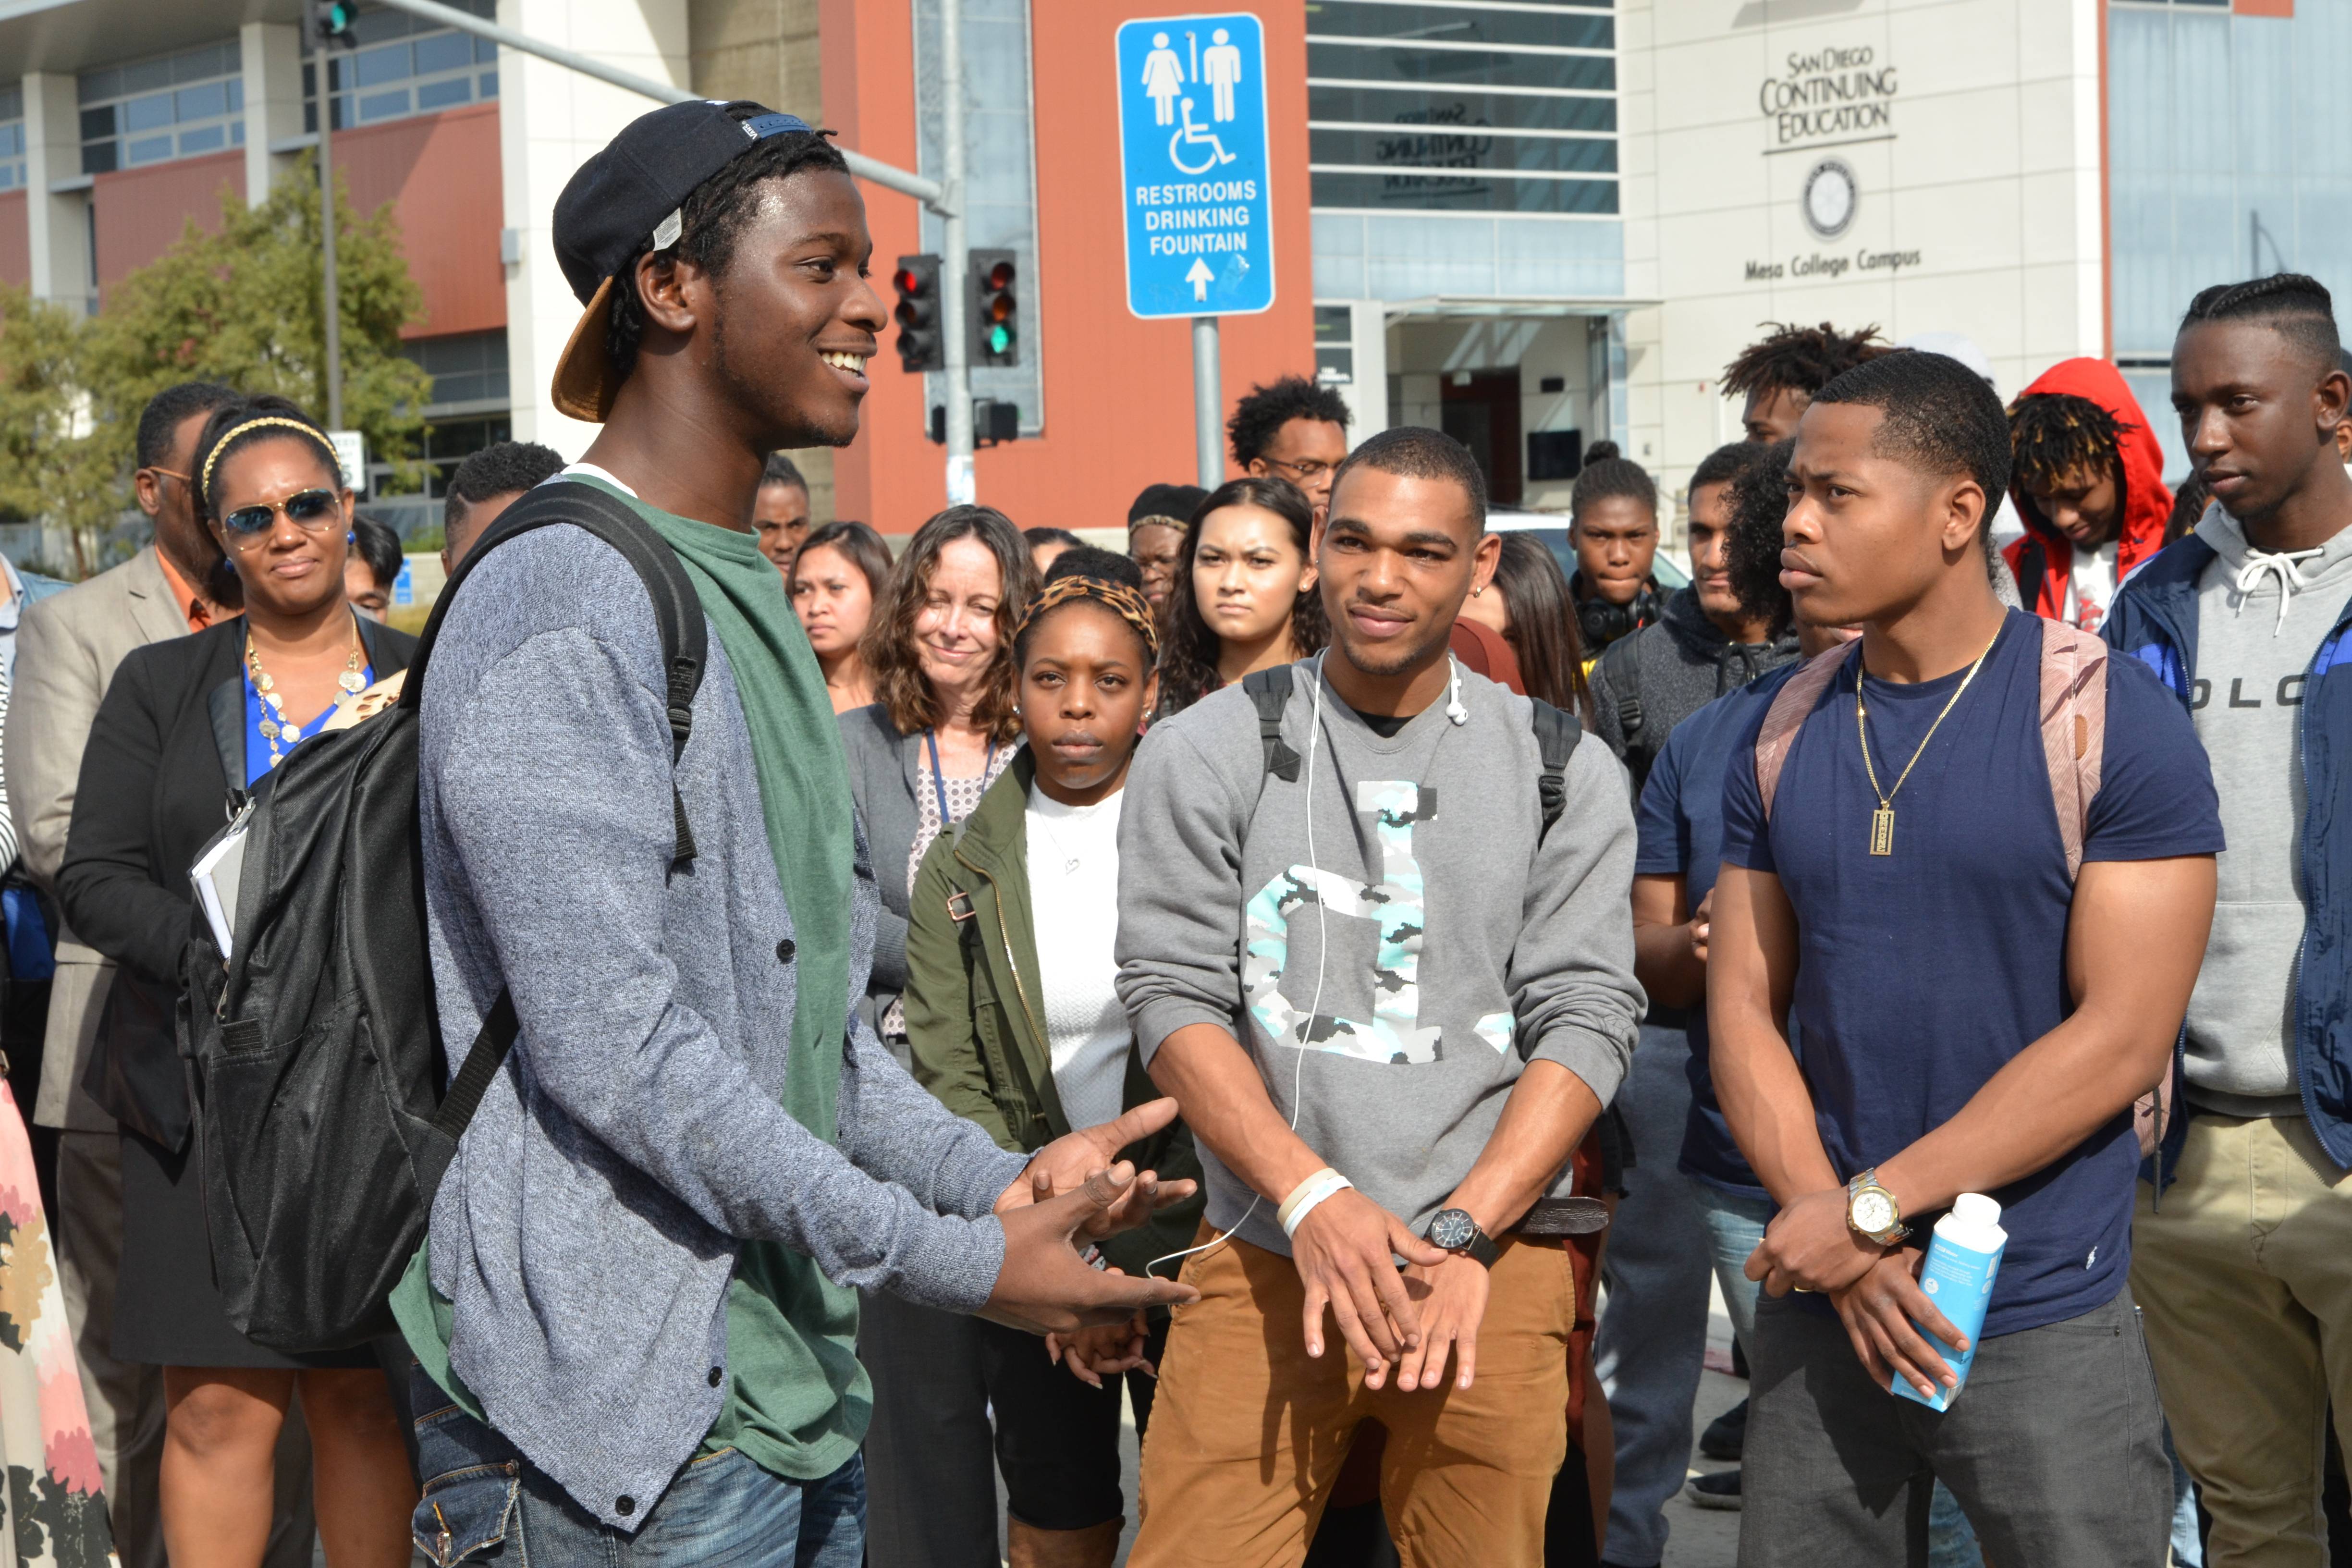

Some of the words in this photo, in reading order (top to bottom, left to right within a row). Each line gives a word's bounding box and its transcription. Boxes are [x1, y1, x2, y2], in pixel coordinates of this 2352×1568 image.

[1761, 67, 1898, 117] CONTINUING
[742, 123, 758, 140] VANS
[1778, 101, 1889, 144] EDUCATION
[1136, 180, 1257, 206] RESTROOMS
[1145, 206, 1250, 231] DRINKING
[1150, 232, 1247, 256] FOUNTAIN
[1745, 260, 1783, 282] Mesa
[1791, 254, 1849, 278] College
[1857, 248, 1920, 271] Campus
